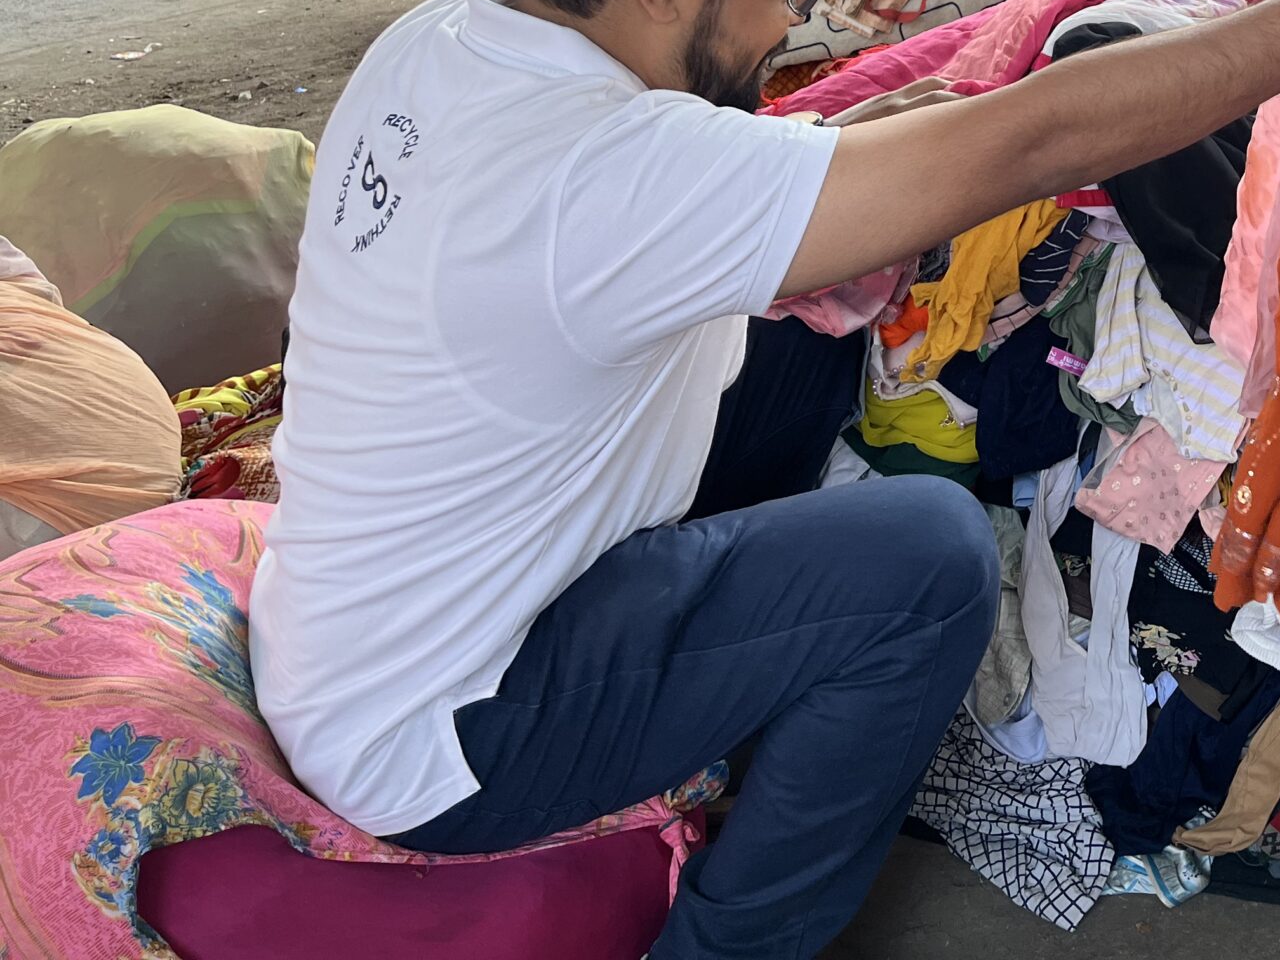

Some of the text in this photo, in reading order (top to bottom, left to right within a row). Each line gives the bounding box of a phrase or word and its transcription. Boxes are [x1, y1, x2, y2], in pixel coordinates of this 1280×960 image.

[382, 113, 420, 160] RECYCLE
[334, 134, 364, 227] RECOVER
[350, 194, 402, 253] RETHINK
